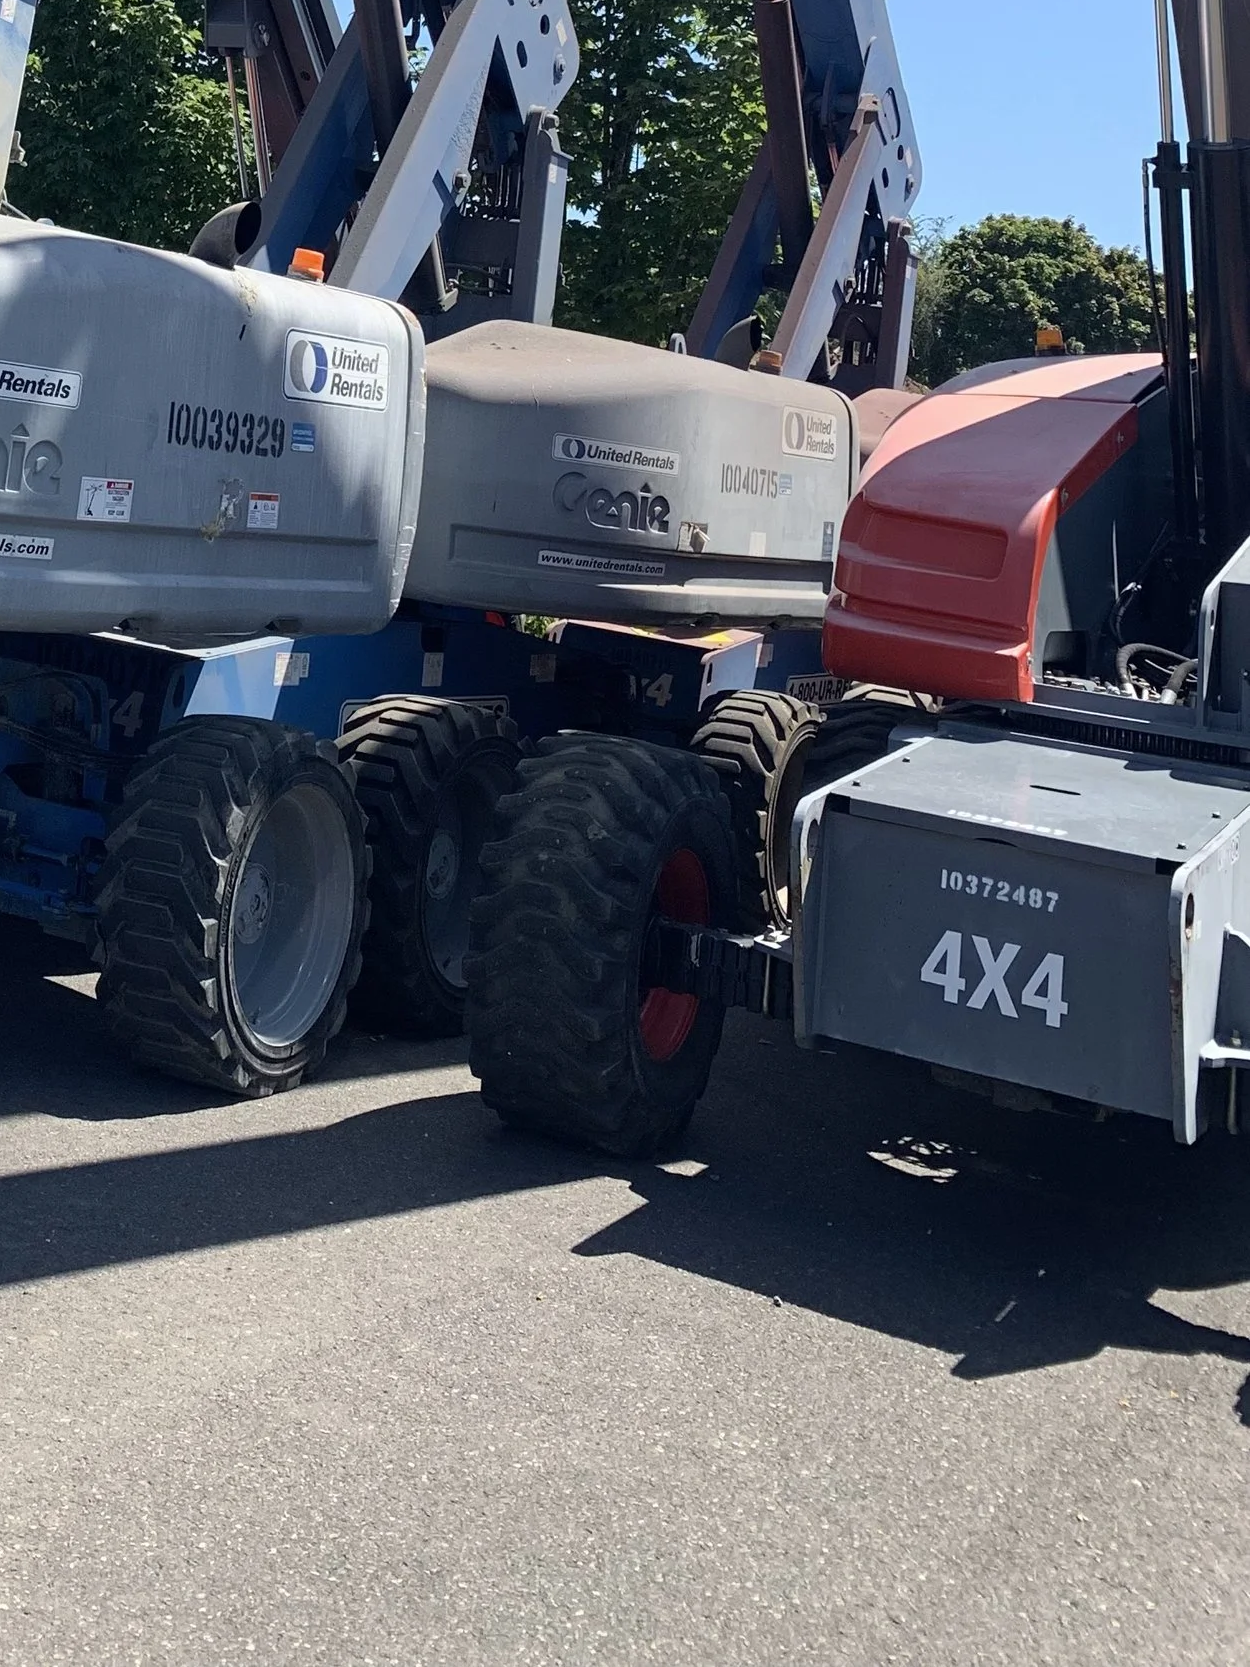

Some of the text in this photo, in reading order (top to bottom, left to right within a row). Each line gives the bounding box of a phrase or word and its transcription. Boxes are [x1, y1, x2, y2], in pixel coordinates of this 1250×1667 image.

[331, 347, 379, 375] United
[330, 372, 384, 404] Rentals
[805, 416, 832, 435] United
[587, 444, 675, 471] United Rentals
[805, 435, 835, 455] Rentals
[553, 471, 670, 535] Genie
[541, 552, 664, 575] www.unitedrentals.com
[940, 868, 1059, 913] 10372487
[920, 929, 1069, 1028] 4X4
